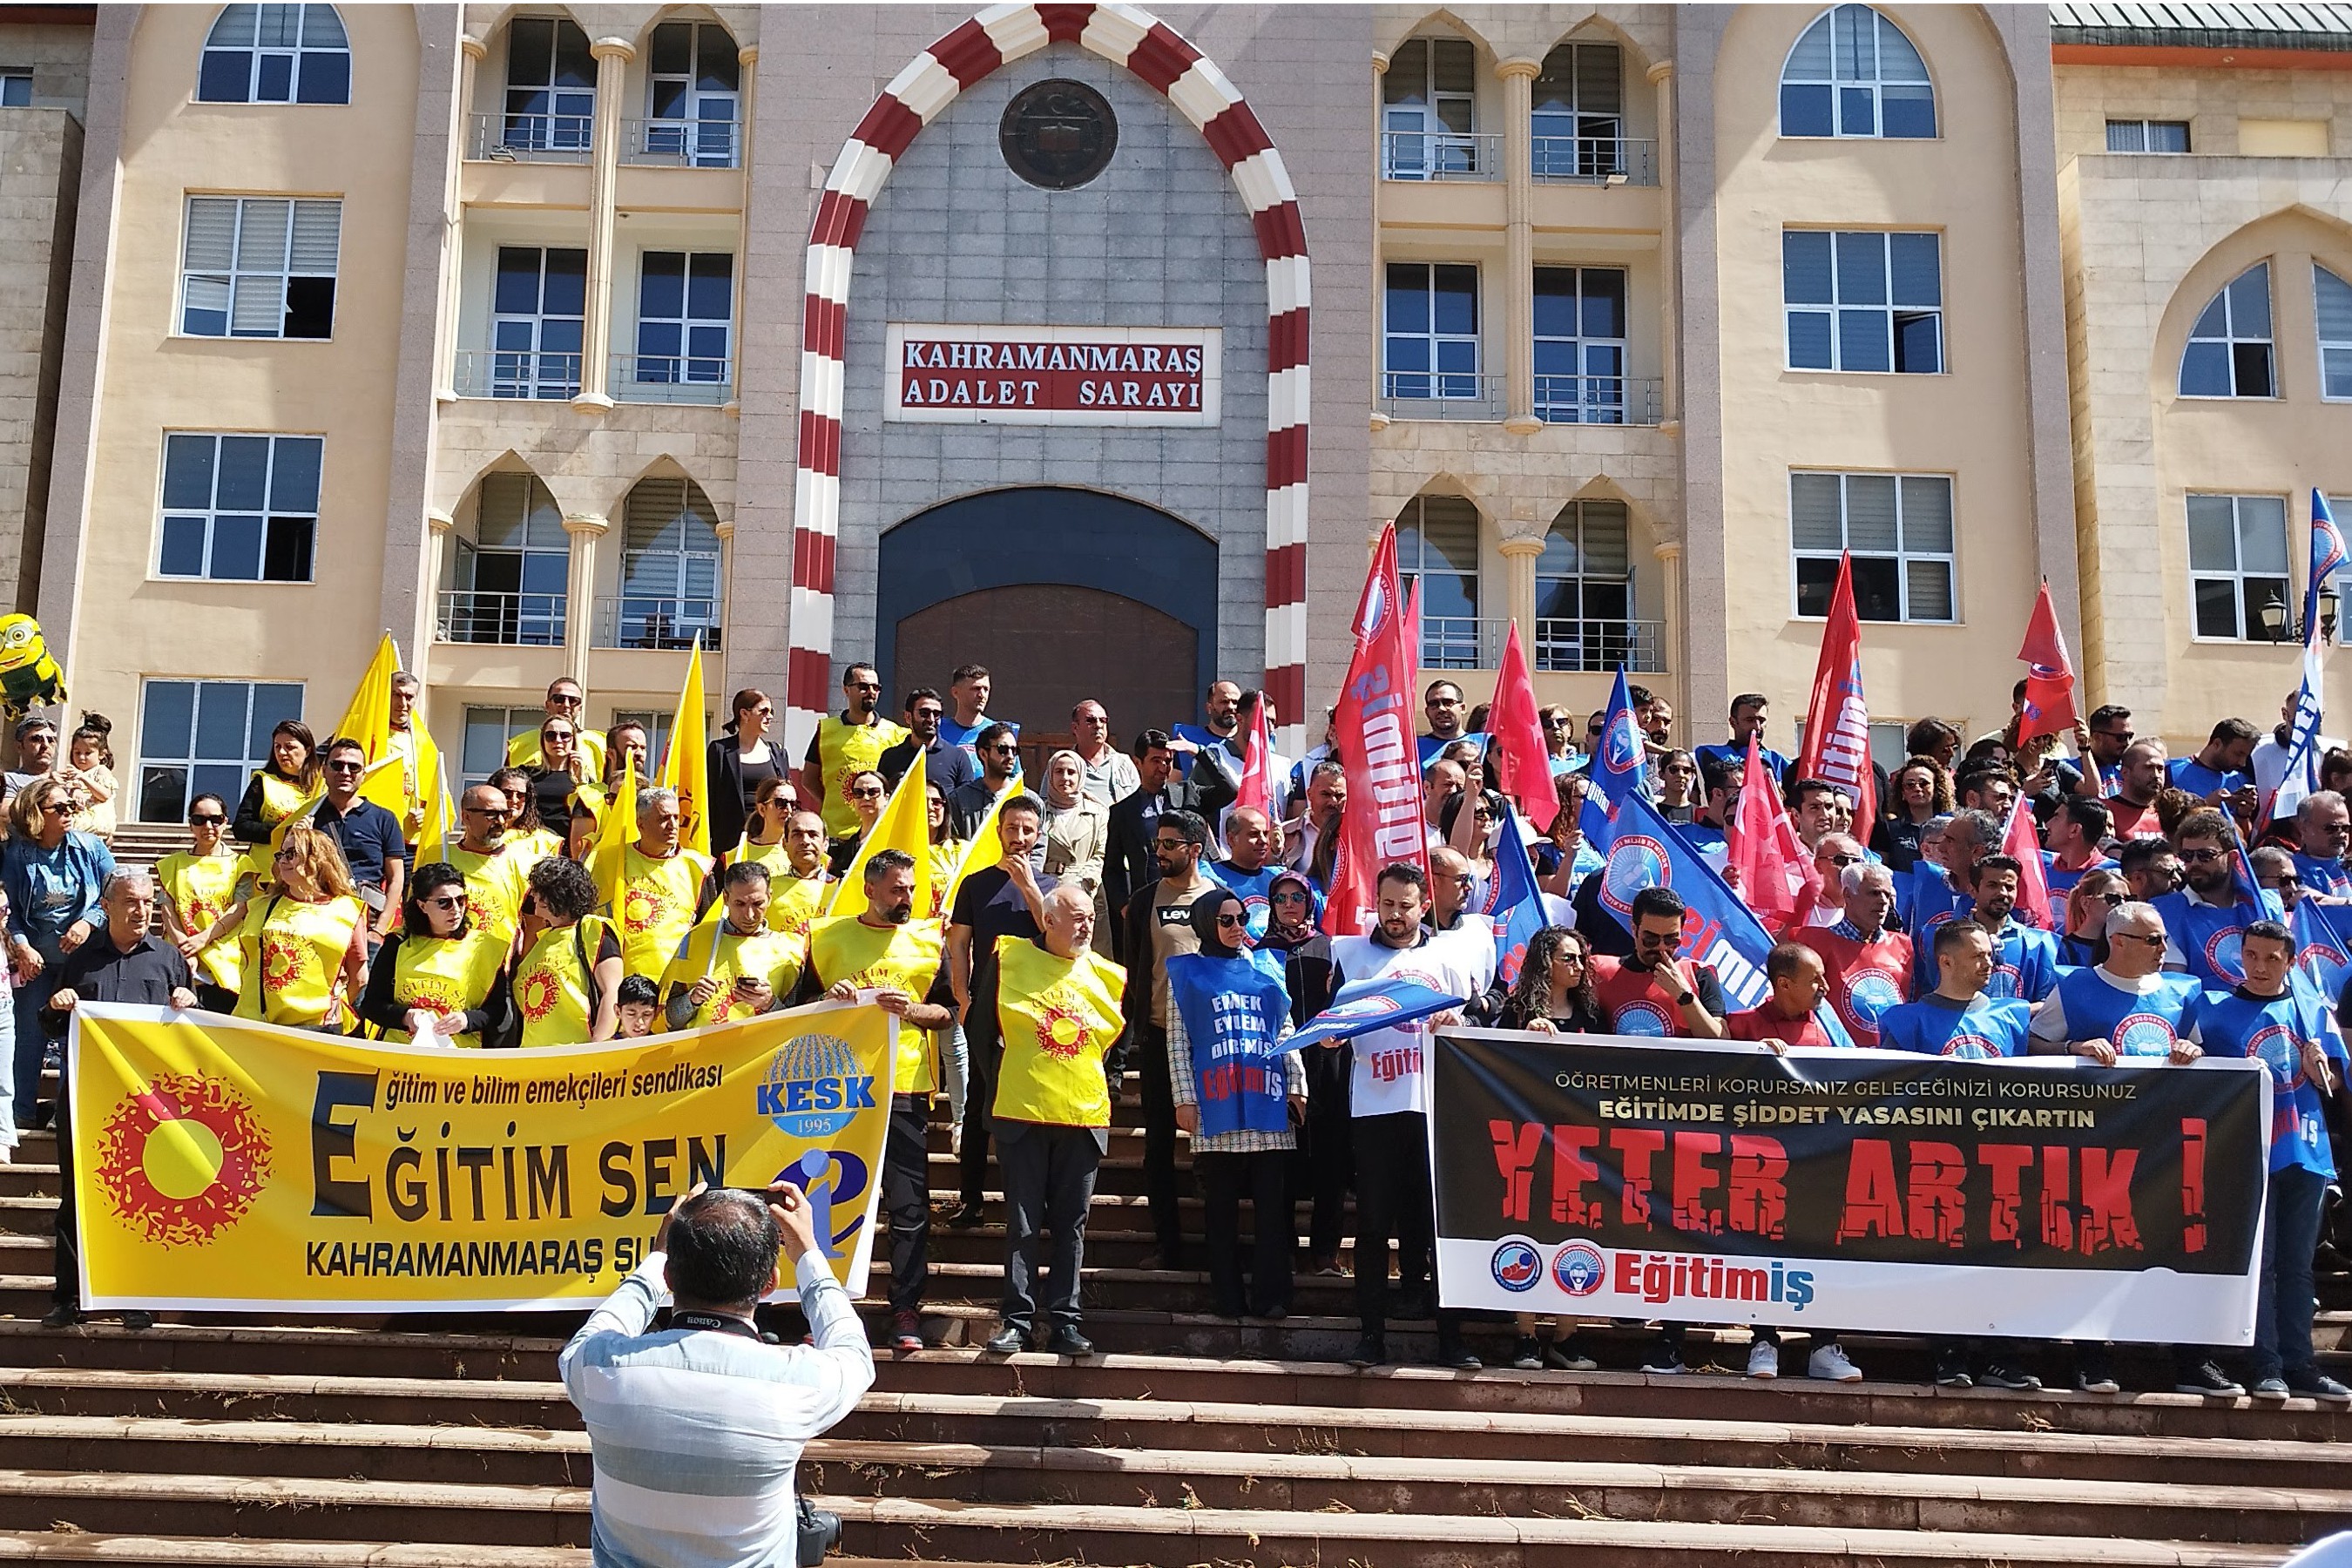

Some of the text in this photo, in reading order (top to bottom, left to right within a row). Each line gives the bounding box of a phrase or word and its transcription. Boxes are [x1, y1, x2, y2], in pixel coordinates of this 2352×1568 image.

[905, 342, 1202, 377] KAHRAMANMARAŞ
[904, 379, 1200, 408] ADALET SARAYI
[1212, 993, 1263, 1014] EMEK
[1213, 1014, 1267, 1035] EYLEM
[1370, 1047, 1424, 1083] Eğiti
[443, 1080, 466, 1105] ve
[470, 1074, 520, 1105] bilim
[525, 1068, 628, 1110] emekçileri
[631, 1061, 724, 1098] sendikası
[757, 1075, 876, 1115] KESK
[1555, 1069, 2138, 1100] ÖĞRETMENLERİ KORURSANIZ GELECEĞİNİZİ KORURSUNUZ
[796, 1117, 833, 1133] 1995
[1598, 1095, 2096, 1132] EĞİTİMDE ŞİDDET YASASINI ÇIKARTIN
[598, 1133, 727, 1218] SEN
[1488, 1118, 2208, 1256] YETER ARTIK !
[307, 1237, 604, 1284] KAHRAMANMARAŞ
[1613, 1251, 1815, 1312] Eğitimiş
